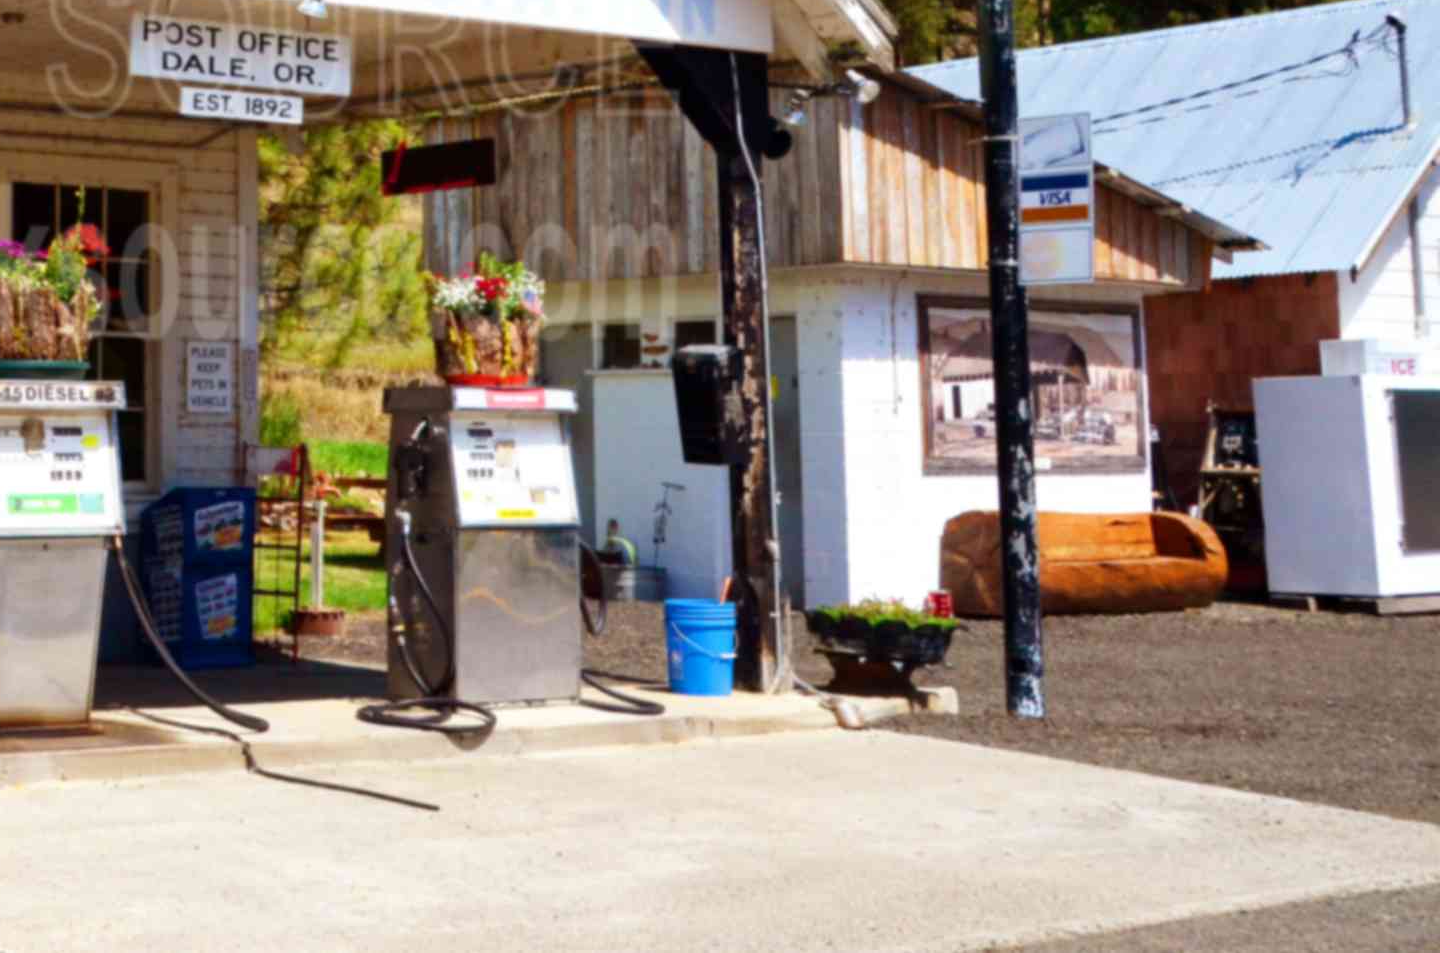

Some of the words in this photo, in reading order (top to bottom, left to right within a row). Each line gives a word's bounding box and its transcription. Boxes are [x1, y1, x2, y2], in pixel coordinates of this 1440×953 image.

[142, 19, 222, 48] POST
[238, 30, 339, 62] OFFICE
[273, 62, 323, 87] OR.
[245, 97, 293, 119] 1892
[1039, 190, 1073, 206] VISA
[1391, 358, 1416, 376] ICE
[25, 385, 89, 401] DIESEL
